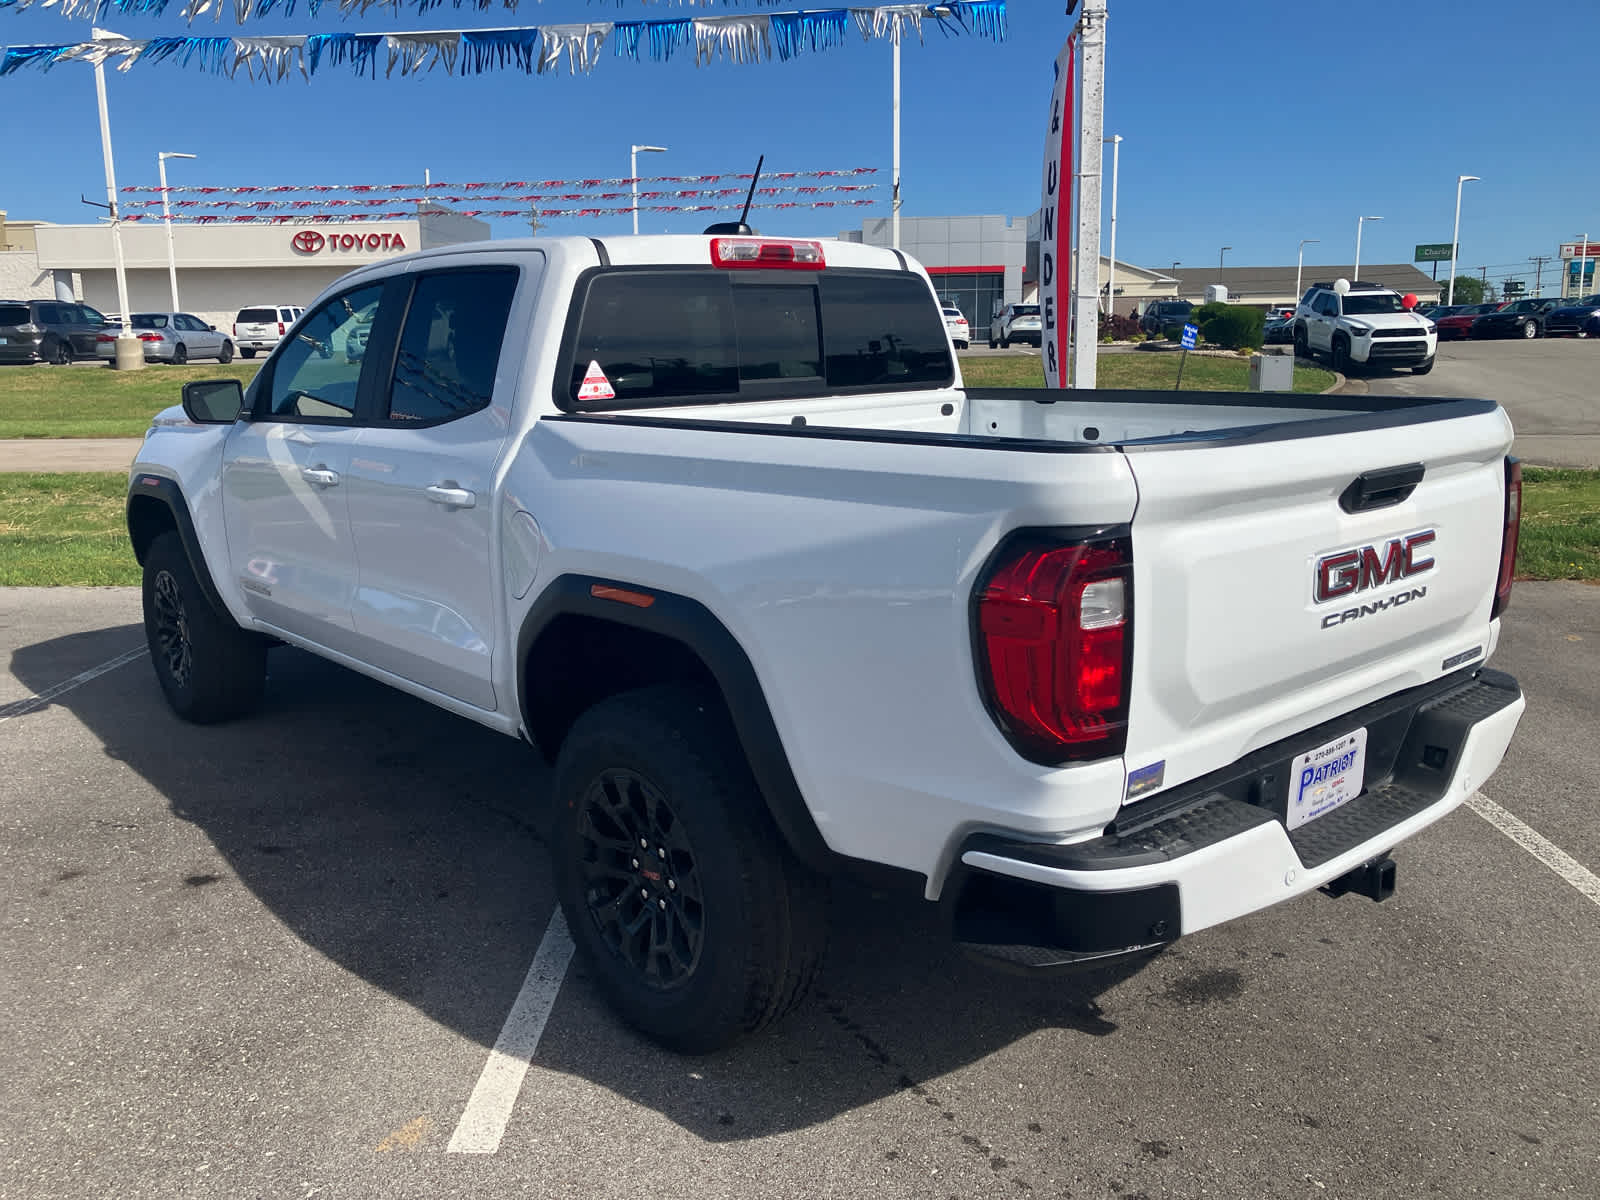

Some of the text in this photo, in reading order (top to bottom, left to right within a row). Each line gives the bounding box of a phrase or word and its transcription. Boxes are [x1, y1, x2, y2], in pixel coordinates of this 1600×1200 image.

[329, 233, 406, 249] TOYOTA
[1042, 161, 1057, 373] UNDER
[1313, 529, 1436, 604] GMC
[1321, 586, 1427, 629] CANYON
[1332, 777, 1345, 788] GMC
